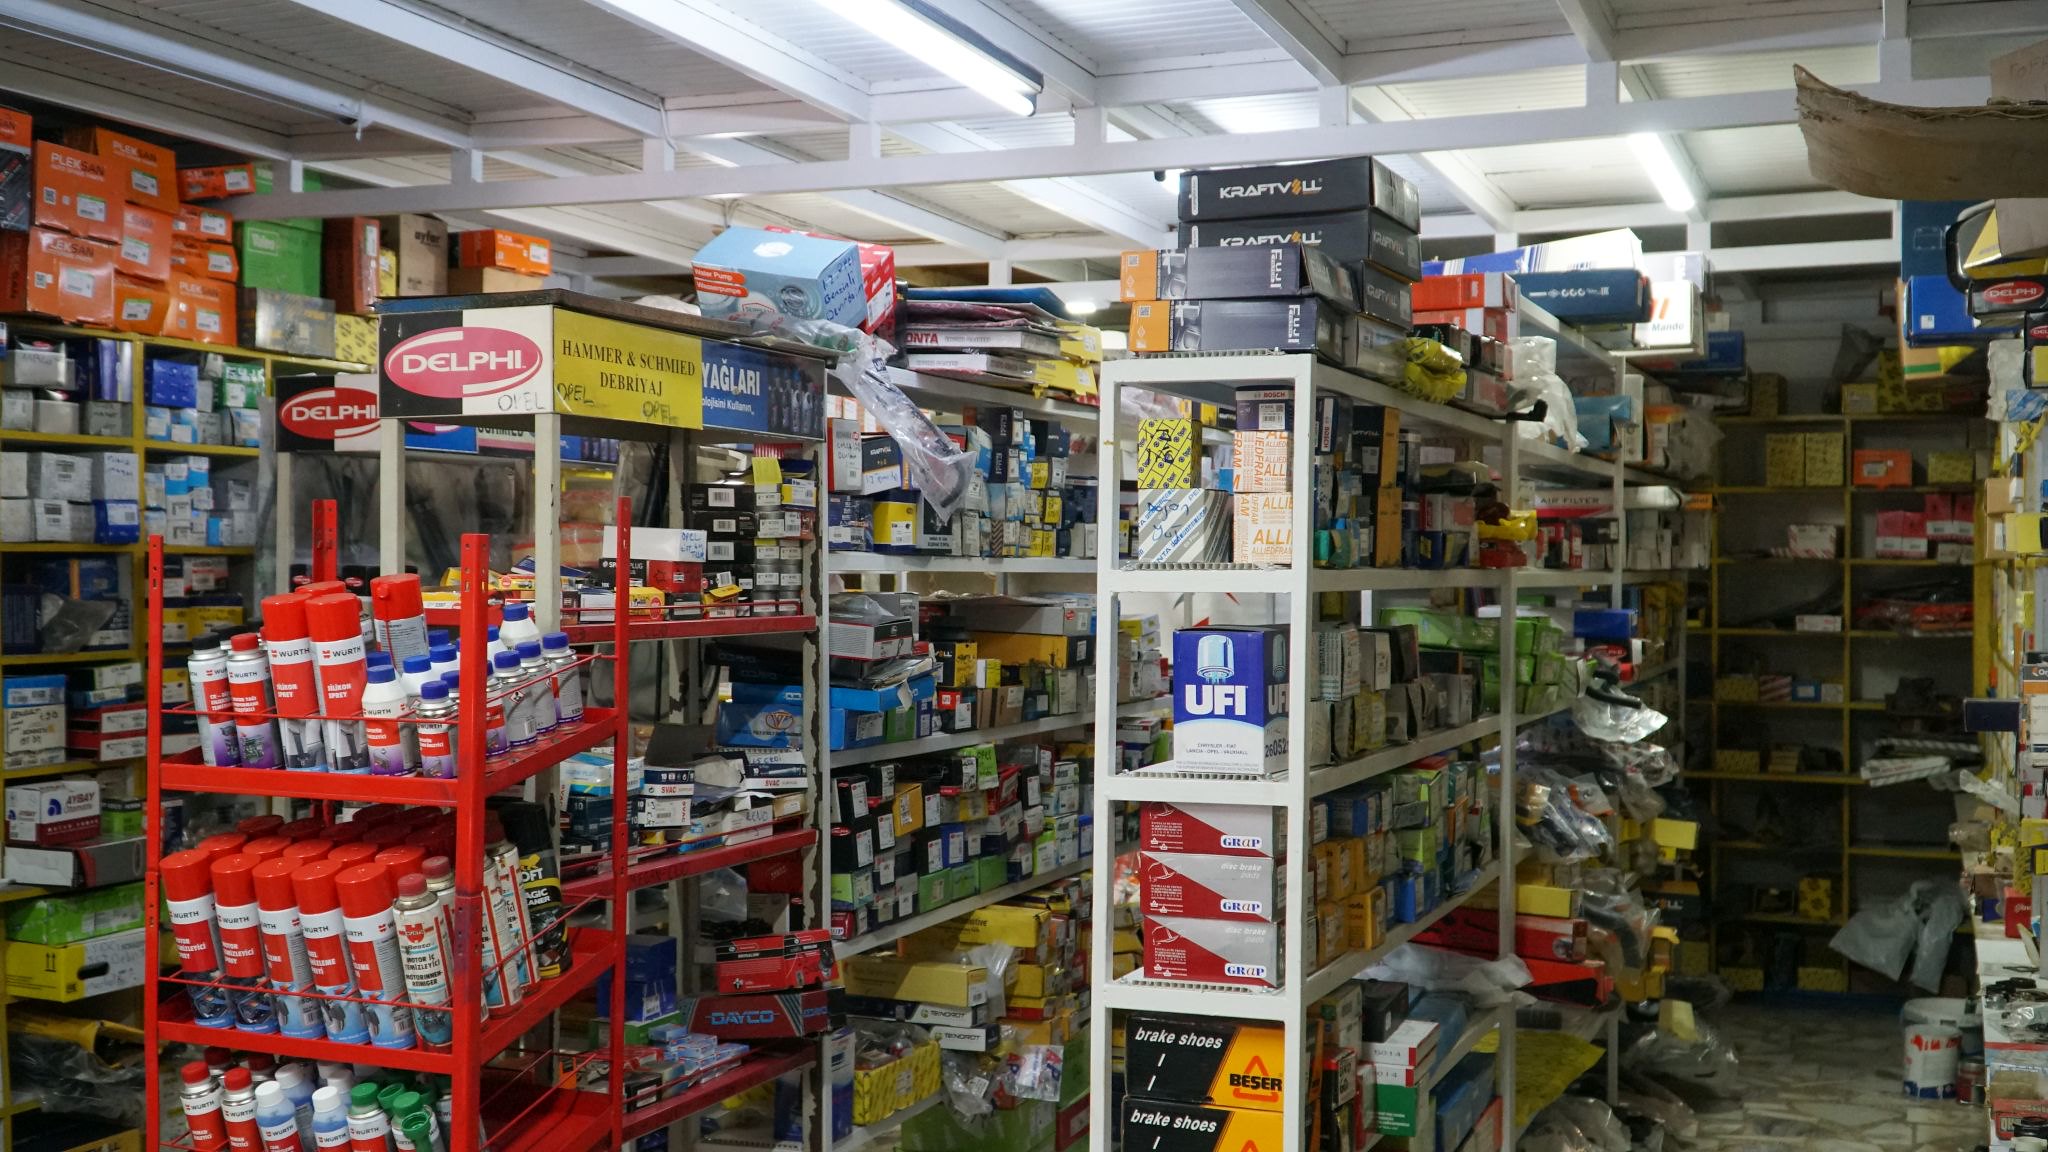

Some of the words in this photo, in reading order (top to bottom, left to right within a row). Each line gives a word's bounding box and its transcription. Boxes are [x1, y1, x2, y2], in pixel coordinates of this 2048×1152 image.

[51, 152, 105, 176] PLEKSAN
[714, 271, 733, 283] Pump
[1990, 287, 2037, 296] DELPHI
[1652, 322, 1684, 331] Mando
[402, 349, 523, 374] DELPHI
[562, 339, 623, 365] HAMMER
[627, 353, 636, 367] &
[640, 354, 696, 377] SCHMIED
[600, 370, 663, 397] DEBRİYAJ
[702, 358, 760, 397] YAĞLARI
[291, 404, 378, 421] DELPHI
[1540, 497, 1563, 505] AIR
[1564, 495, 1600, 505] FILTER
[1185, 684, 1248, 716] UFI
[1221, 863, 1238, 871] disc
[1239, 863, 1262, 872] brake
[1244, 927, 1266, 935] brake
[712, 1010, 774, 1025] DAYCO
[1135, 1028, 1174, 1044] brake
[1179, 1034, 1223, 1049] shoes
[1230, 1073, 1282, 1091] BESER
[1130, 1109, 1170, 1127] brake
[1173, 1116, 1217, 1133] shoes
